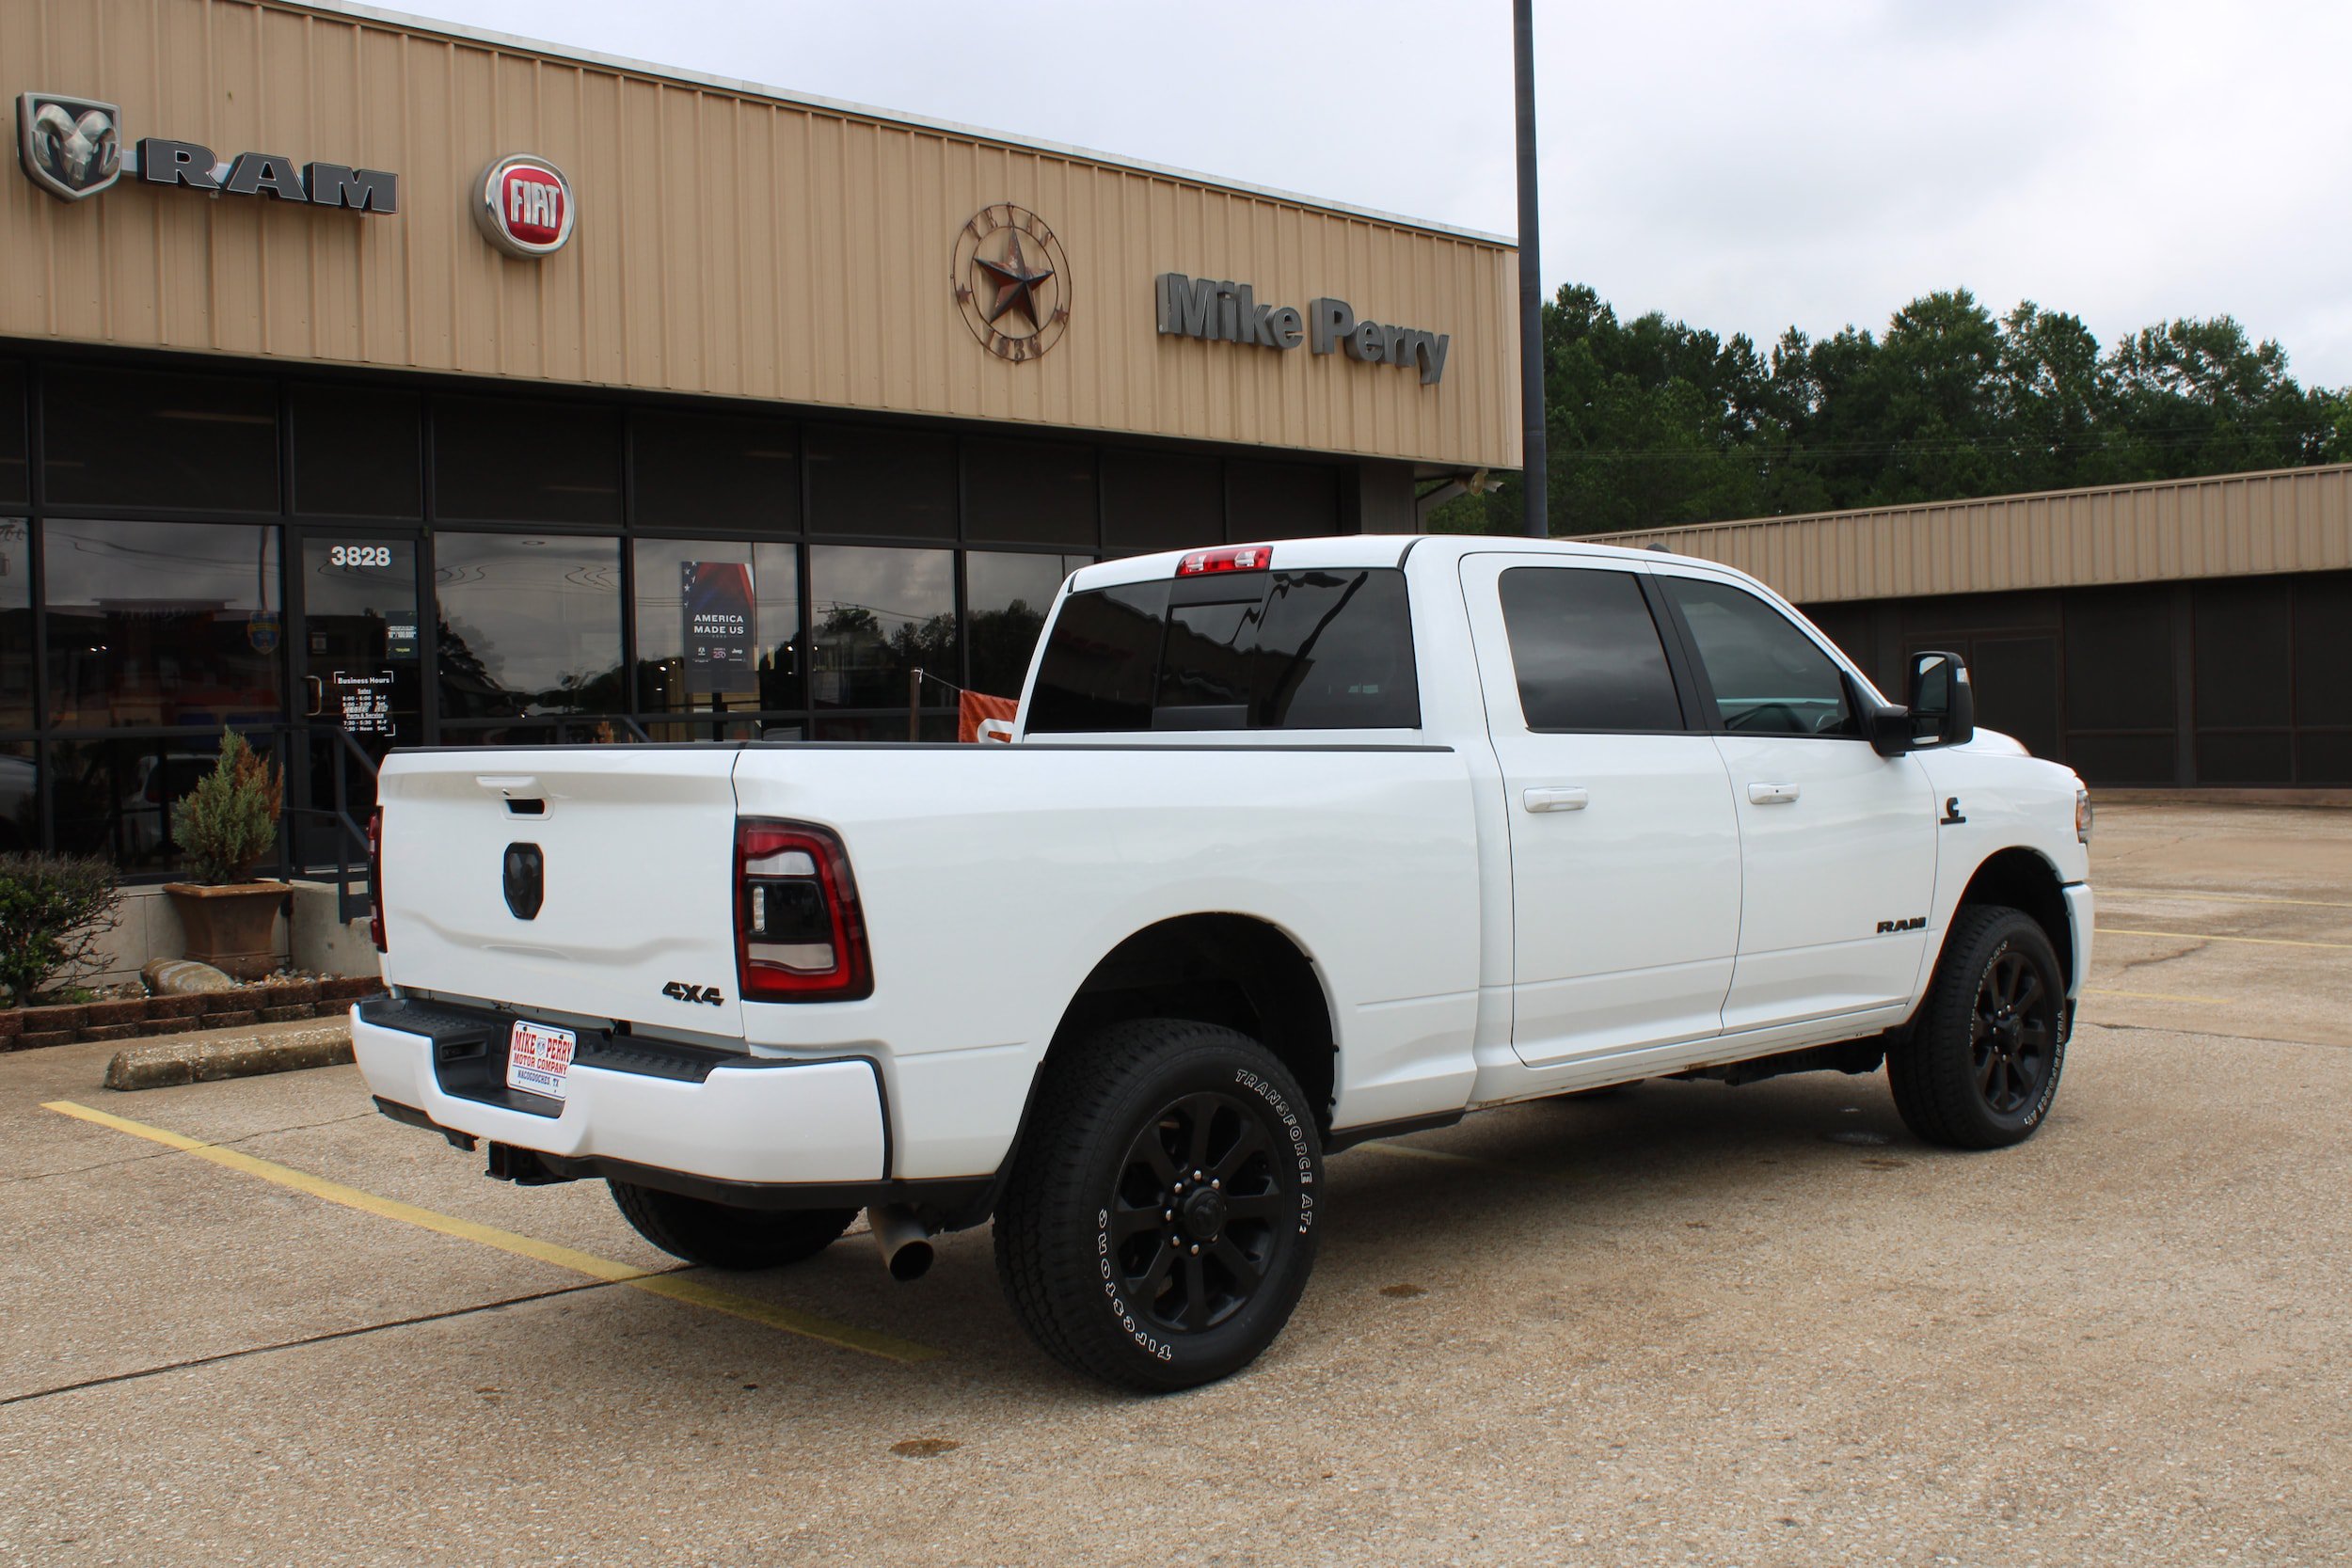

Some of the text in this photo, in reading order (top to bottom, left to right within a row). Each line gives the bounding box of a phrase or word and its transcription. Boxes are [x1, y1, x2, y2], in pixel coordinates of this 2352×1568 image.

[136, 138, 399, 214] RAM
[509, 178, 560, 230] FIAT
[1155, 272, 1450, 386] Mike Perry
[331, 546, 391, 566] 3828
[693, 614, 744, 624] AMERICA
[693, 626, 744, 635] MADE US
[1877, 916, 1927, 933] RAM
[513, 1031, 573, 1063] MIKE PERRY
[513, 1053, 568, 1075] MOTOR COMPANY
[553, 1078, 560, 1087] TX
[1234, 1069, 1313, 1184] TRANSFORCE
